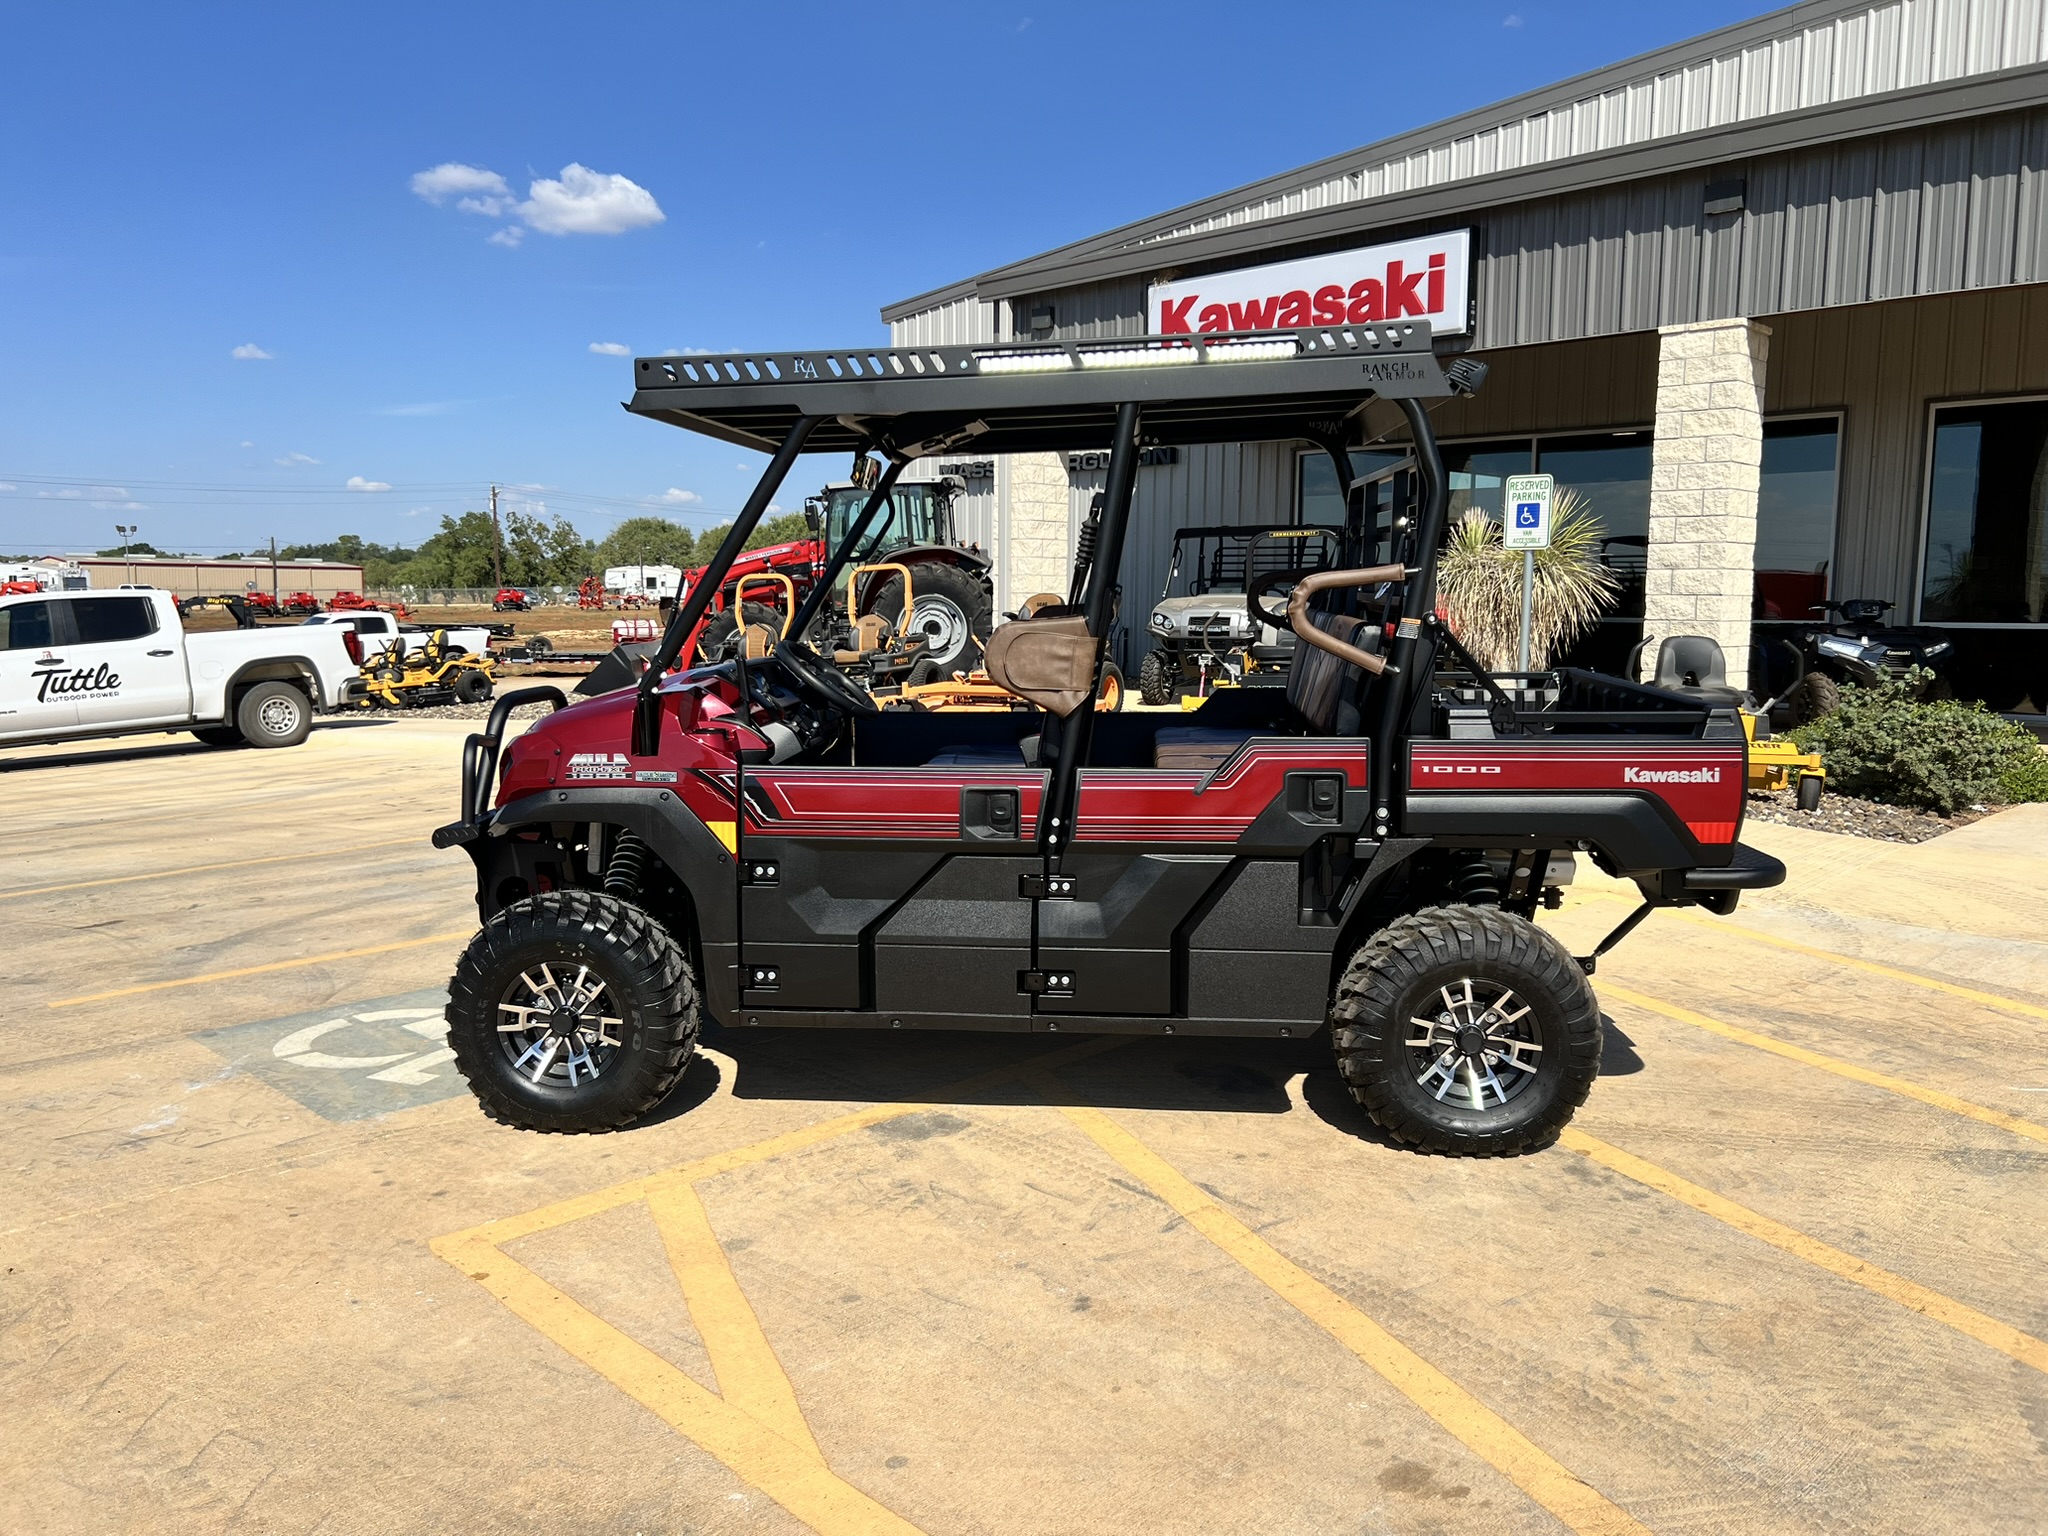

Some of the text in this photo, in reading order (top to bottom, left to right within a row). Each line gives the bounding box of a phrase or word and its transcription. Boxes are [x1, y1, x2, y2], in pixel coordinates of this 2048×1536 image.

[1161, 252, 1446, 348] Kawasaki
[1362, 362, 1409, 378] RANCH
[1367, 366, 1425, 381] ARMOR
[939, 460, 994, 478] MASS
[1510, 480, 1549, 491] RESERVED
[1512, 491, 1546, 501] PARKING
[31, 662, 122, 703] Tuttle
[46, 691, 120, 703] OUTDOOR POWER
[566, 753, 631, 767] MULE
[1422, 765, 1501, 774] 1000
[1624, 766, 1721, 783] Kawasaki
